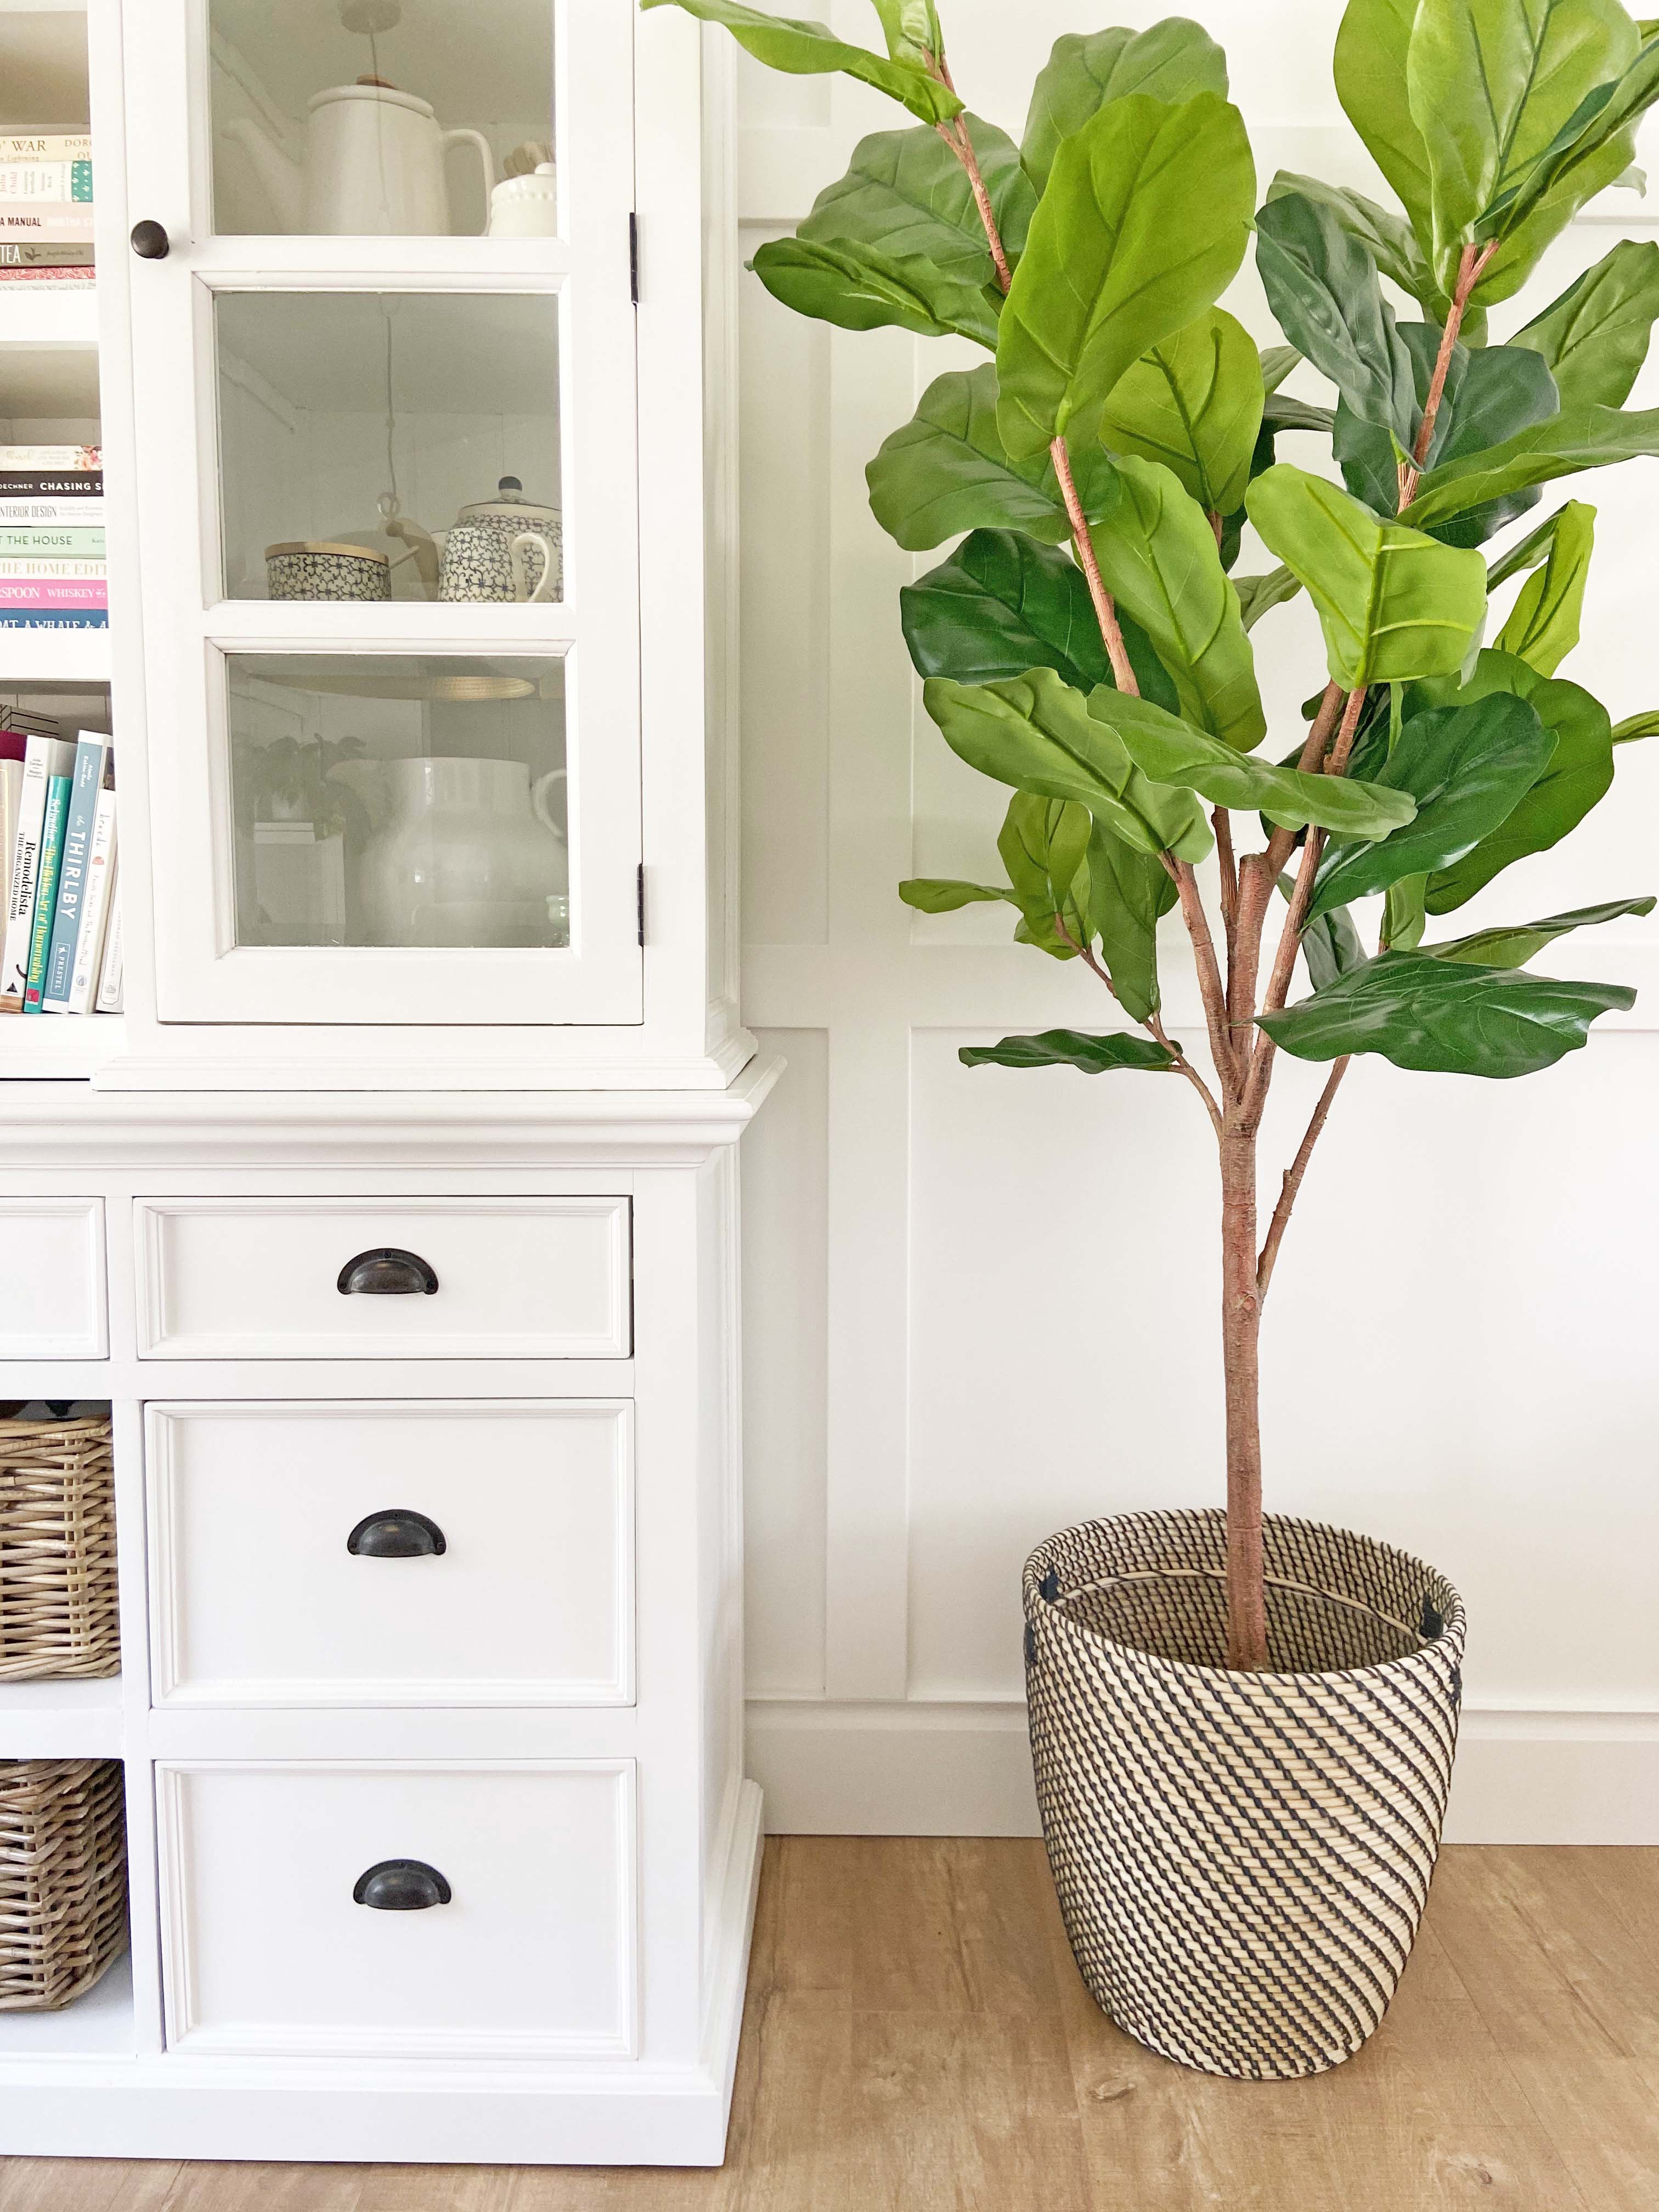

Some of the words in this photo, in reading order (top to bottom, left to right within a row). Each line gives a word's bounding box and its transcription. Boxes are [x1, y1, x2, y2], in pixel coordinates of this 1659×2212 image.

[12, 140, 47, 151] WAR
[8, 217, 42, 227] MANUAL
[0, 245, 21, 263] TEA
[40, 482, 91, 490] CHASING
[95, 482, 102, 490] S
[31, 505, 57, 518] DESIGN
[7, 535, 29, 545] THE
[33, 535, 72, 545] HOUSE
[27, 562, 71, 575] HOME
[75, 563, 106, 575] EDIT
[47, 588, 94, 598] WHISKEY
[13, 849, 24, 895] ORGANIZED
[18, 841, 36, 916] Remodelista
[60, 831, 86, 920] THIRLBY
[10, 897, 19, 921] HOME
[38, 899, 50, 911] Art
[37, 913, 47, 923] of
[27, 925, 47, 984] Homemaking
[55, 956, 65, 989] PRESTEL
